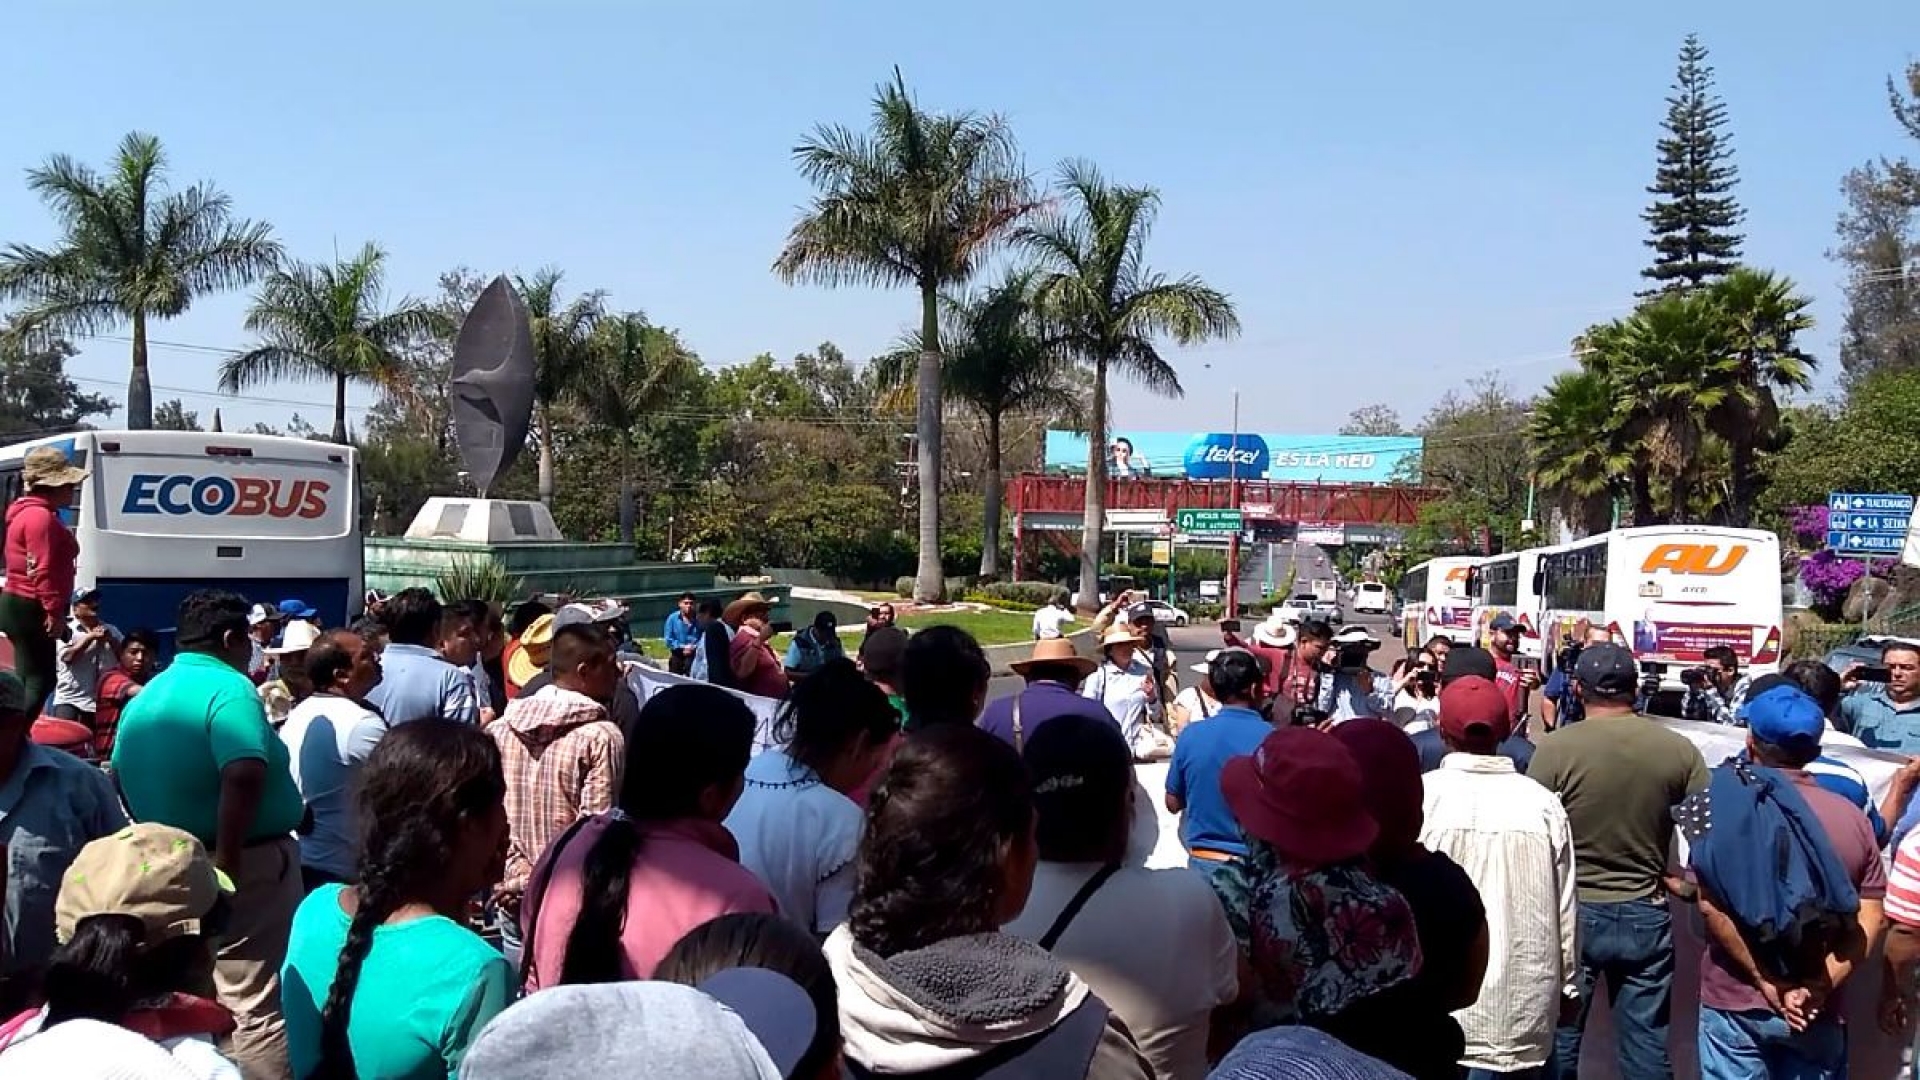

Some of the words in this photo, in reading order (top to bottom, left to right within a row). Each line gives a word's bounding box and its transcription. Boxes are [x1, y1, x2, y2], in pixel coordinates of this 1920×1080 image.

[1206, 443, 1260, 465] telcel
[1276, 453, 1300, 467] ES
[1304, 453, 1329, 467] LA
[1335, 453, 1376, 468] RED
[121, 474, 331, 519] ECOBUS
[1868, 517, 1879, 529] LA
[1882, 518, 1907, 529] SELVA
[1640, 544, 1749, 576] AU
